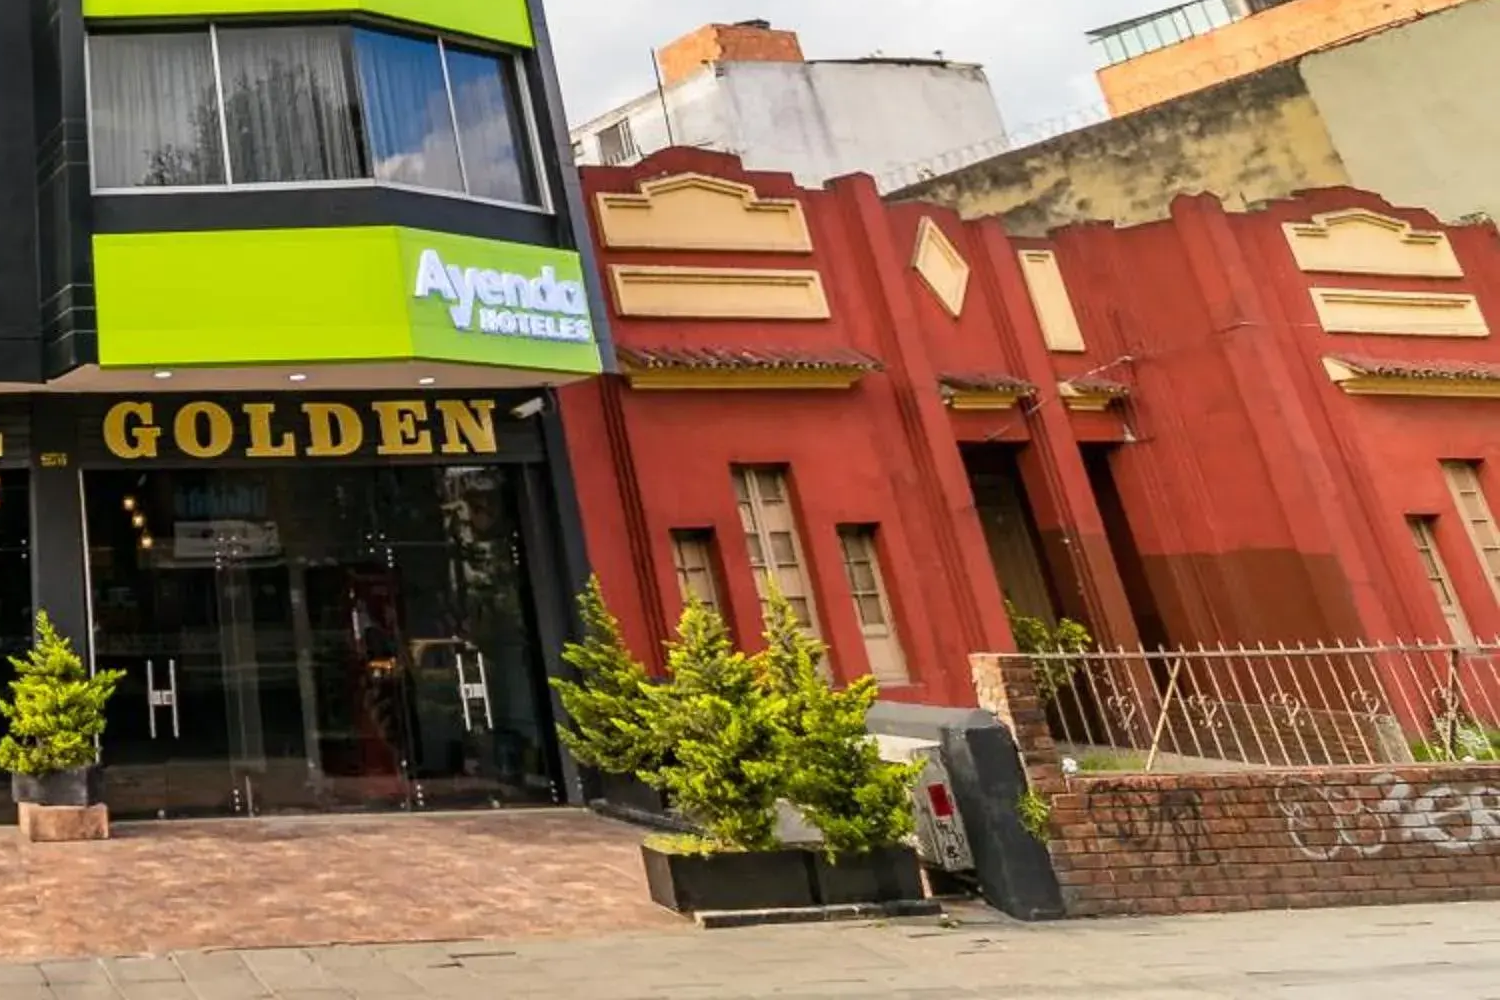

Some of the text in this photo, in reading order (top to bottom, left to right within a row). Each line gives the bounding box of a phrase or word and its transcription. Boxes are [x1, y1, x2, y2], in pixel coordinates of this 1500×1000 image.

[414, 248, 588, 329] Ayenda
[478, 307, 592, 341] HOTELES
[102, 398, 498, 459] GOLDEN
